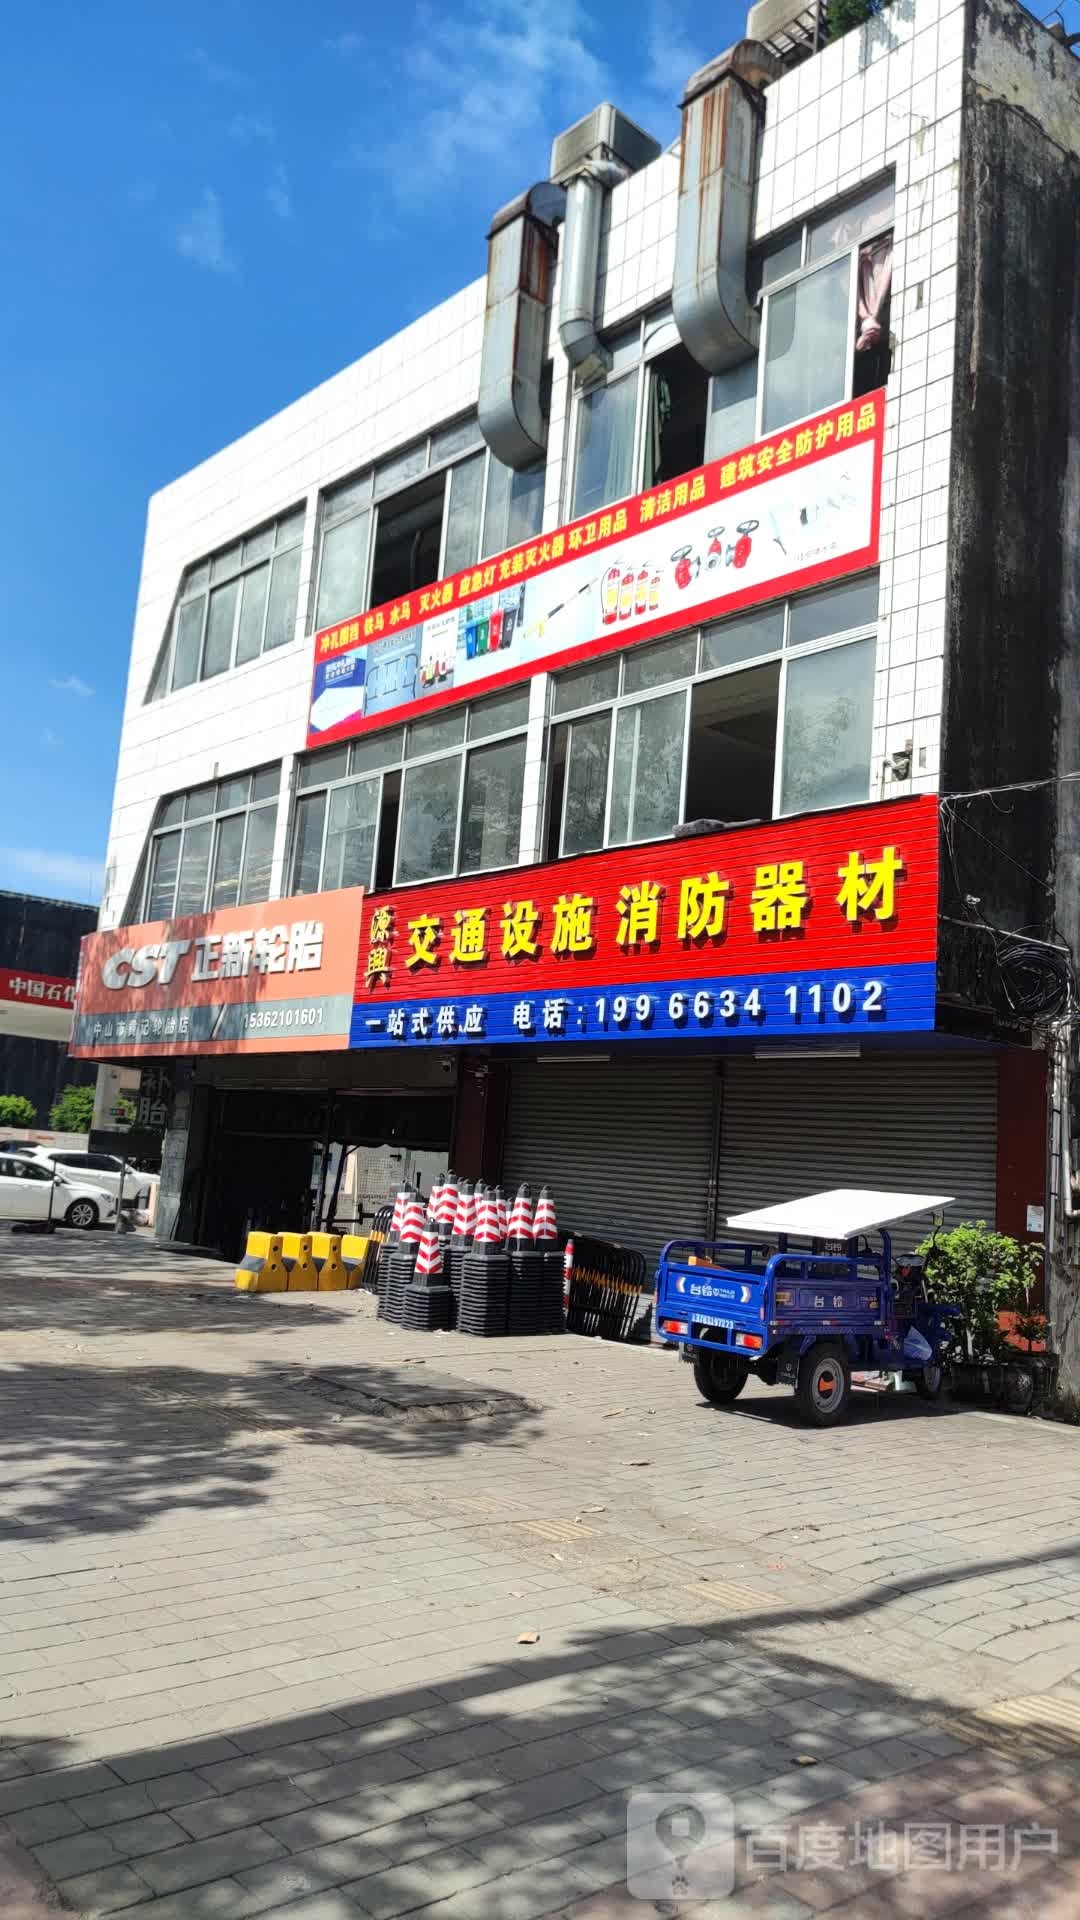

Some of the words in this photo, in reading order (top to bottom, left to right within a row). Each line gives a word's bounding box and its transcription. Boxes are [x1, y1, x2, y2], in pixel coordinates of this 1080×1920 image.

[390, 601, 411, 625] 水马
[419, 582, 453, 613] 灭火器
[458, 564, 497, 598] 应急灯
[499, 534, 563, 580] 充装灭火器
[569, 508, 627, 551] 环卫用品
[640, 474, 705, 523] 清洁用品
[720, 401, 876, 489] 建筑安全防护用品
[405, 847, 903, 968] 交通设施消防器材
[102, 940, 192, 990] CST
[191, 920, 324, 982] 正新轮胎
[244, 1007, 324, 1029] 15362101601
[365, 1004, 484, 1036] 一站式供应
